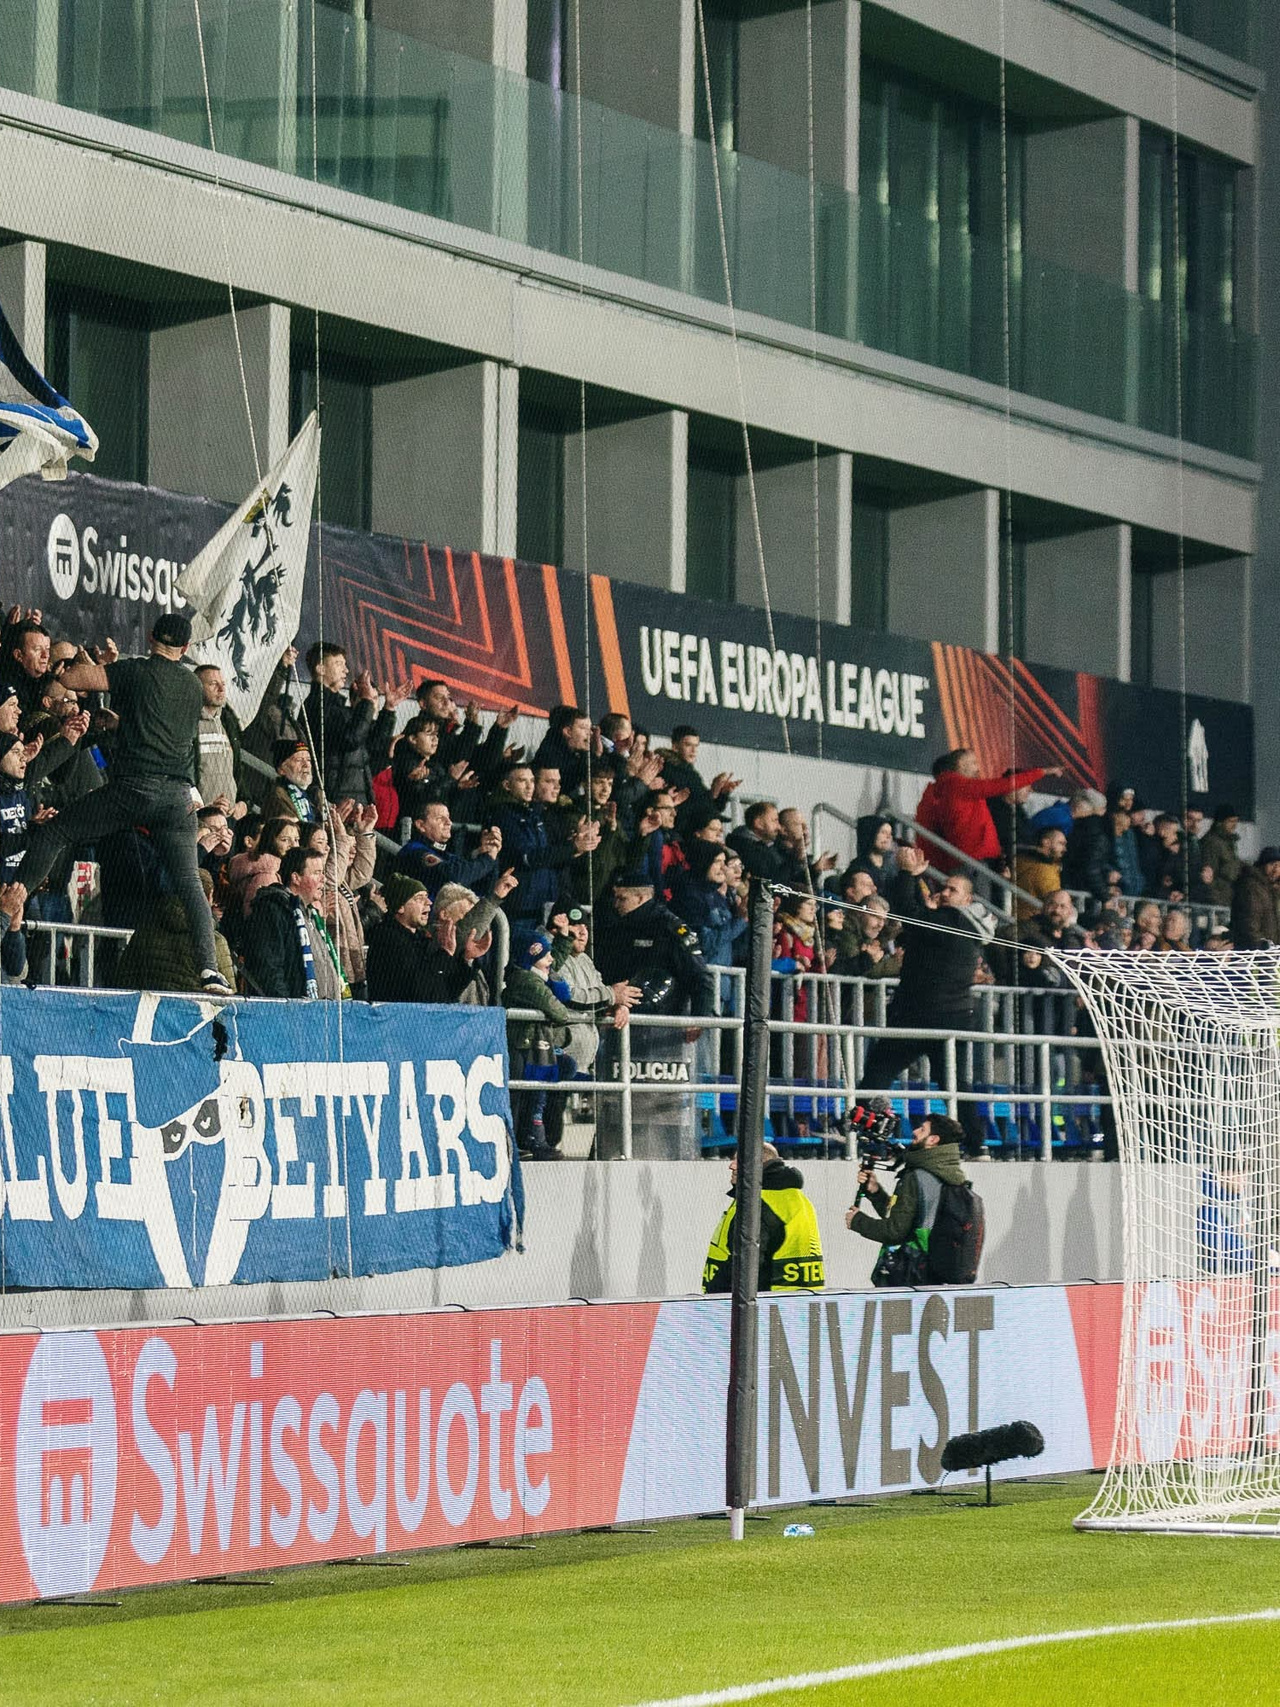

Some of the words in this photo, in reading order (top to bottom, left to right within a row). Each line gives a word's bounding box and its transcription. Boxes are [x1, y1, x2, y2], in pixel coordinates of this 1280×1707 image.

[639, 625, 719, 706] UEFA
[721, 640, 825, 723] EUROPA
[219, 1053, 512, 1222] BETYARS
[129, 1337, 554, 1565] Swissquote
[748, 1294, 995, 1499] NVEST
